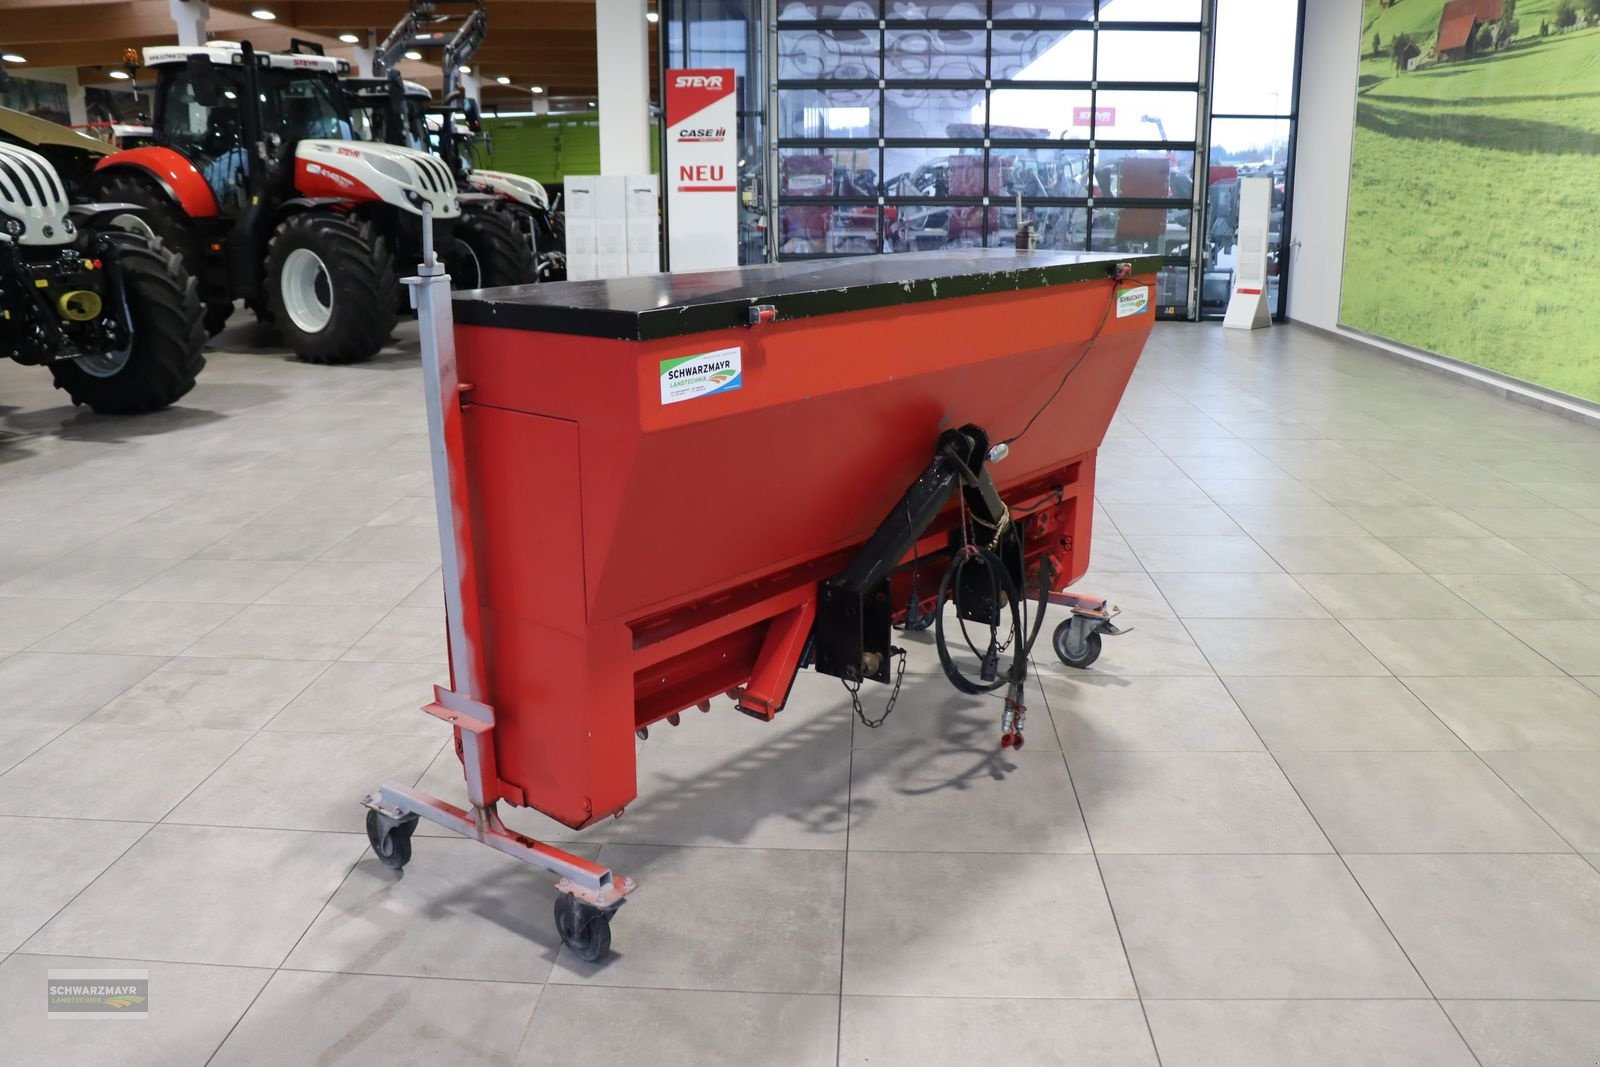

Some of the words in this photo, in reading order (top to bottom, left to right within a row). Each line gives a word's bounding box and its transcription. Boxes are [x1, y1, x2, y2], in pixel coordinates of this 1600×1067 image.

[294, 59, 319, 67] STEYR
[675, 76, 723, 90] STEYR
[1080, 111, 1112, 121] STYR
[680, 129, 714, 137] CASE
[680, 165, 724, 181] NEU
[668, 360, 730, 380] SCHWARZMAYR
[670, 376, 707, 388] LANDTECHNIK
